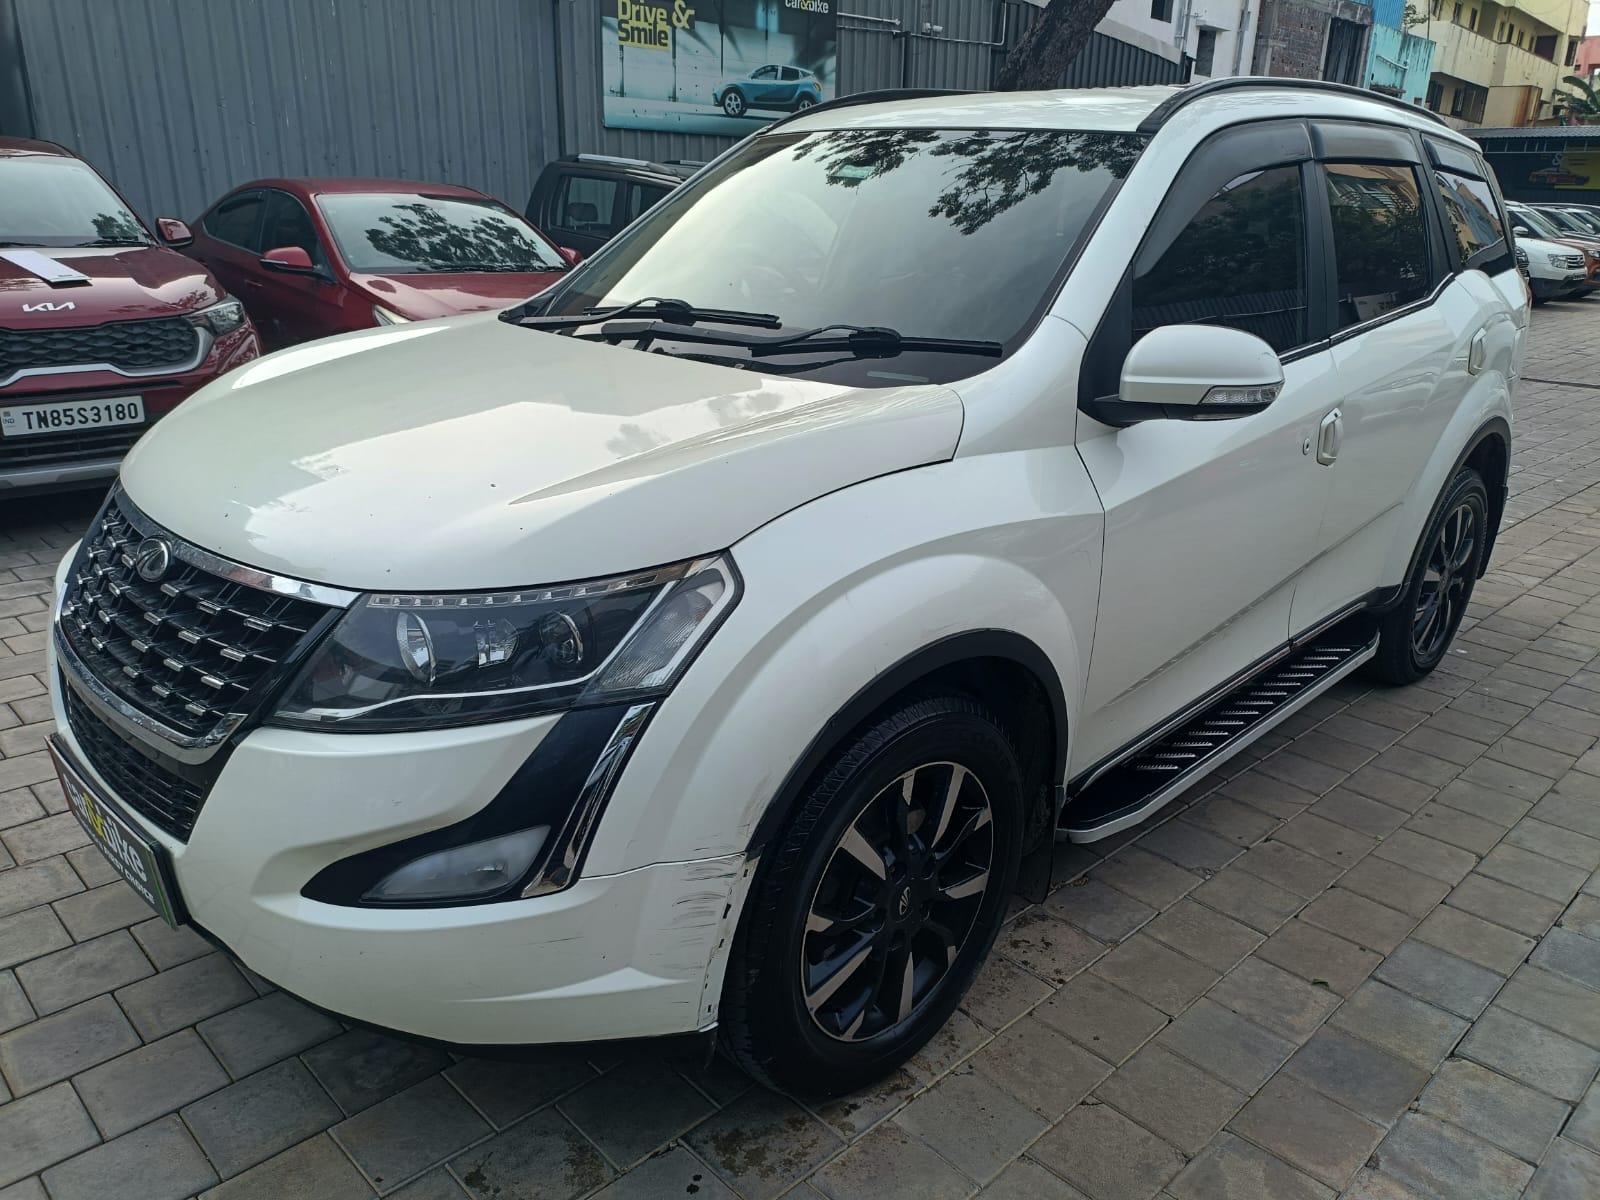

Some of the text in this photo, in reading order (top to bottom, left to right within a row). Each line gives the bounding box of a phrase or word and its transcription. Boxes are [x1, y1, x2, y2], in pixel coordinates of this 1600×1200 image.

[618, 0, 695, 29] Drive &
[618, 19, 669, 47] Smile
[22, 402, 138, 430] TN85S3180
[62, 773, 147, 882] car&bike
